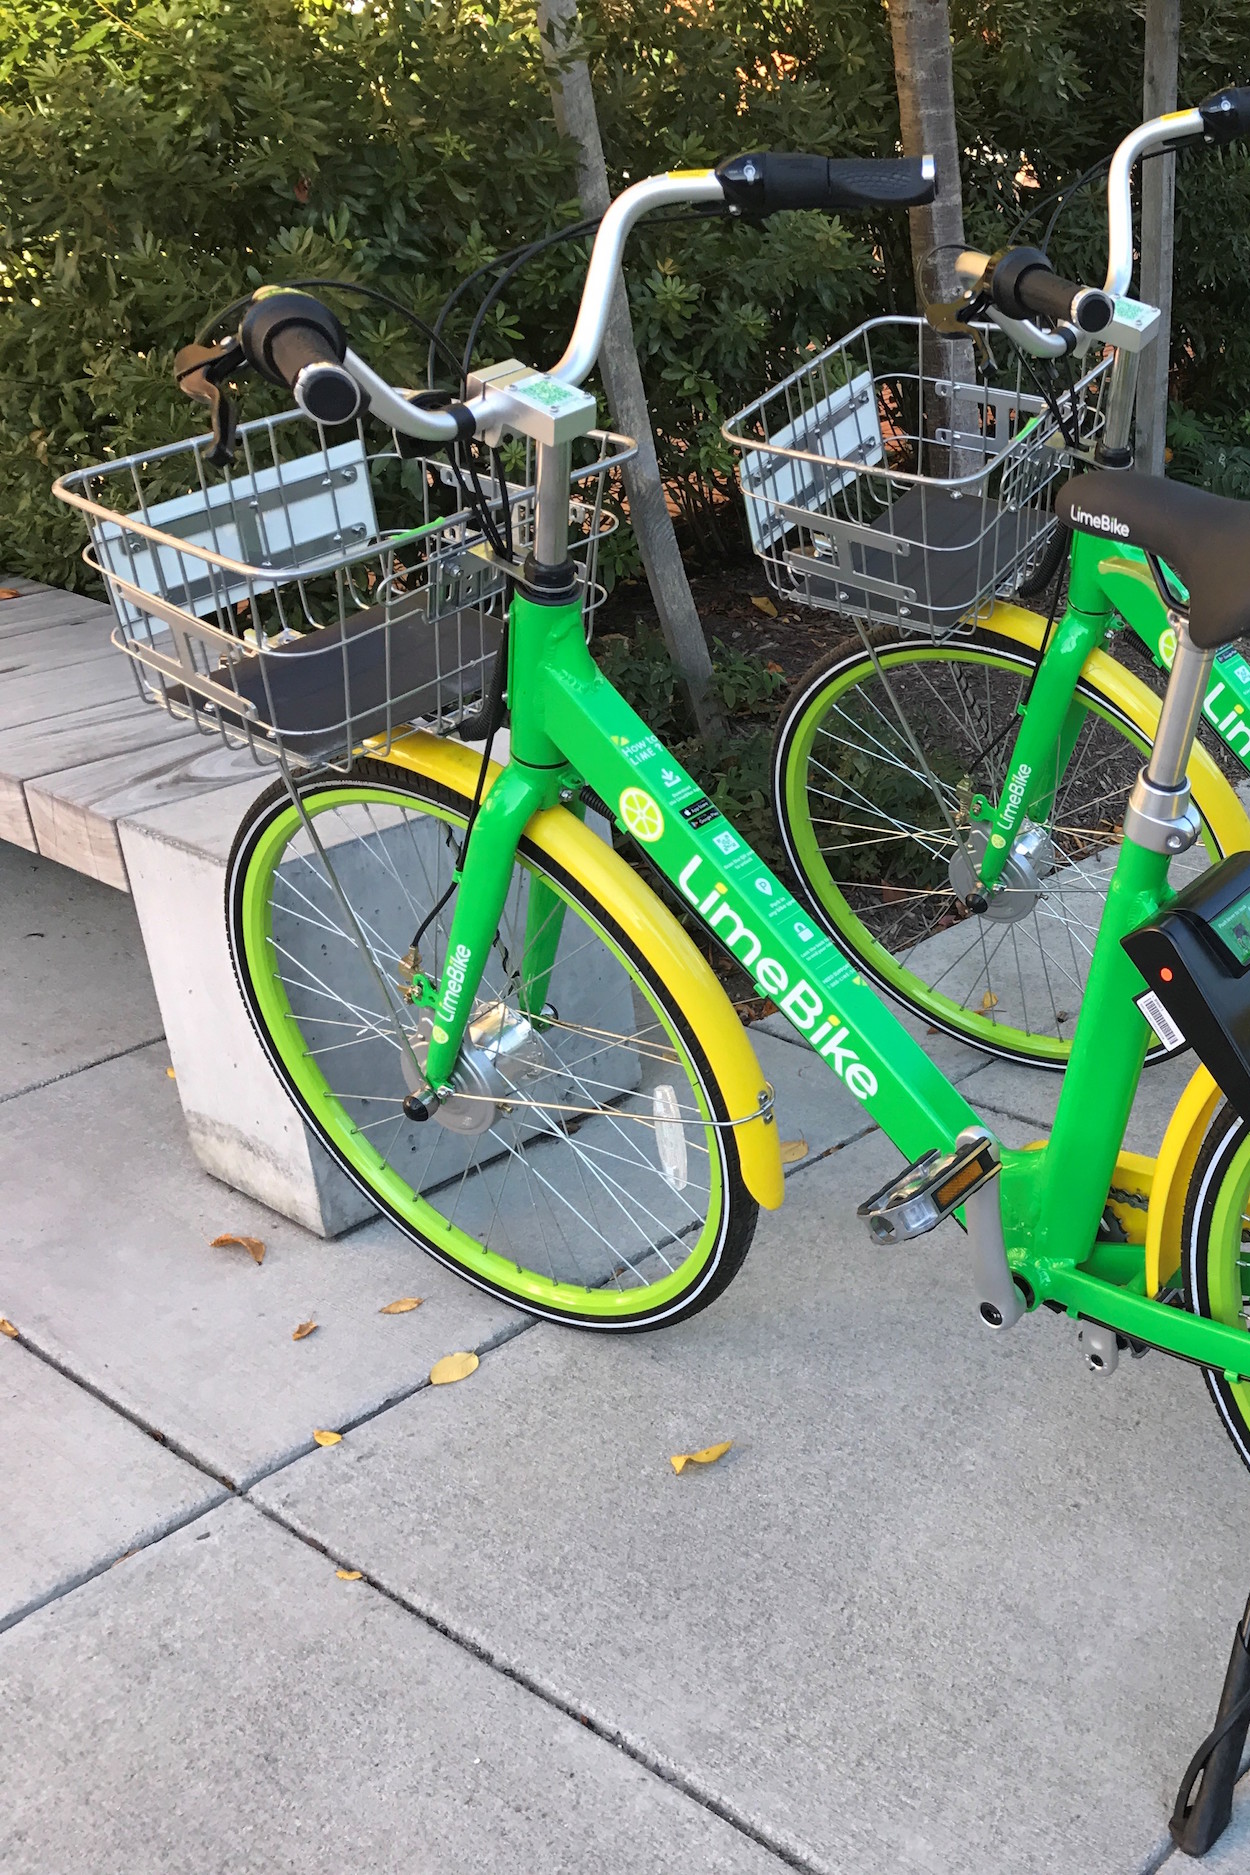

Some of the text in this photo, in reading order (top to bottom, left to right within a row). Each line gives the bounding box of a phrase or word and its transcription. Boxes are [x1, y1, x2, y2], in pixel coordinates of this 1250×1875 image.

[1070, 505, 1130, 539] LimeBike
[621, 735, 658, 757] How to
[630, 743, 663, 766] LIME ?
[997, 763, 1032, 831] LimeBike
[436, 944, 472, 1023] LimeBike
[678, 855, 879, 1101] LimeBike
